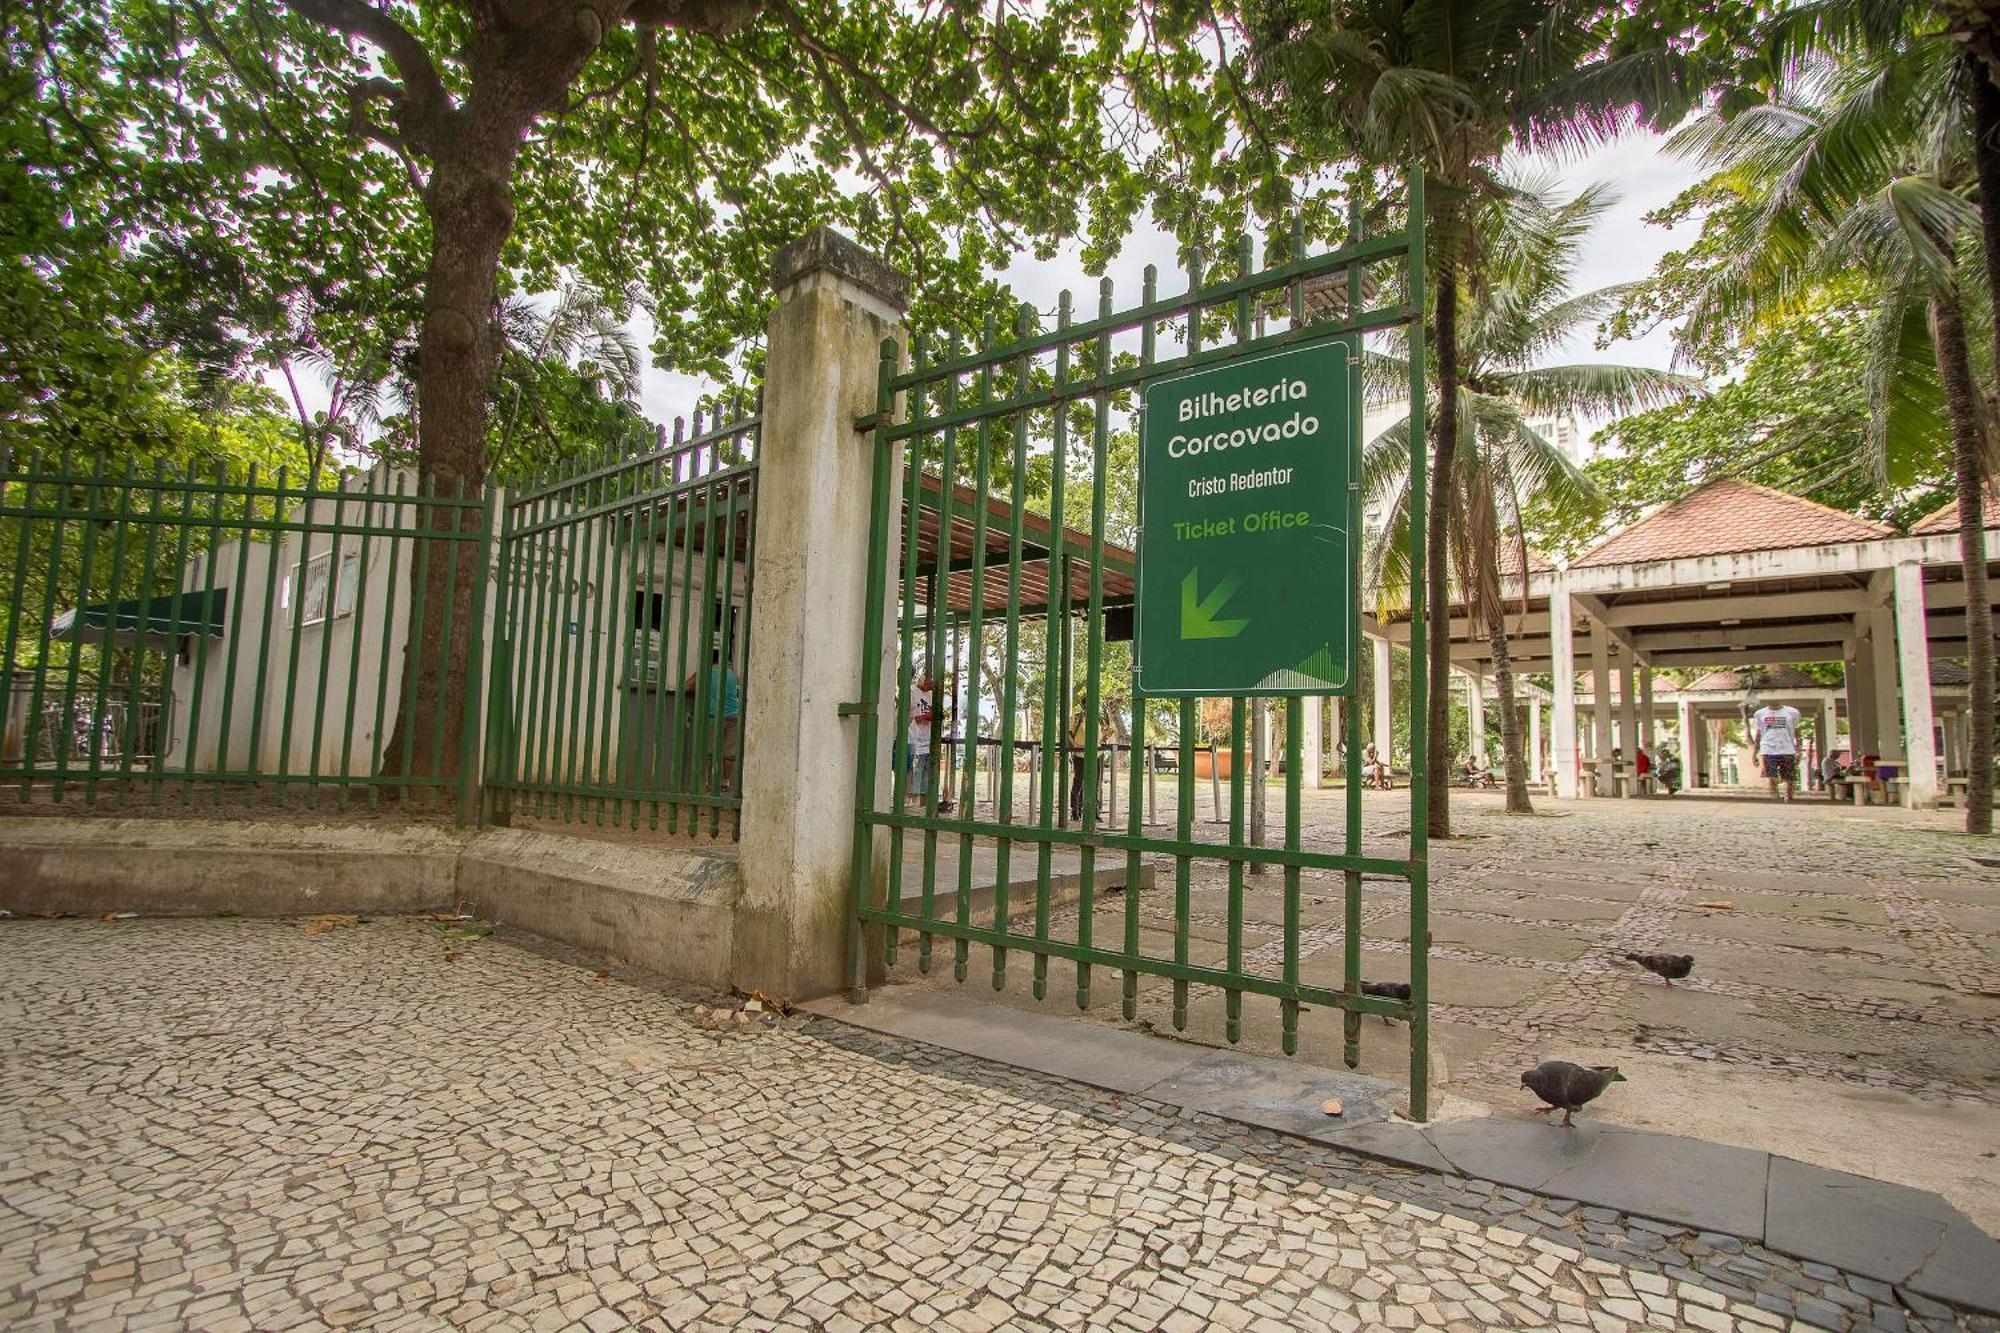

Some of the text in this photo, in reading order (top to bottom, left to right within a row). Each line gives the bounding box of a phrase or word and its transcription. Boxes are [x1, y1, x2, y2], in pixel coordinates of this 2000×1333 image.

[1178, 377, 1307, 422] Bilheteria
[1168, 411, 1320, 459] Corcovado
[1188, 467, 1294, 498] Cristo Redentor
[1173, 510, 1311, 542] Ticket Office
